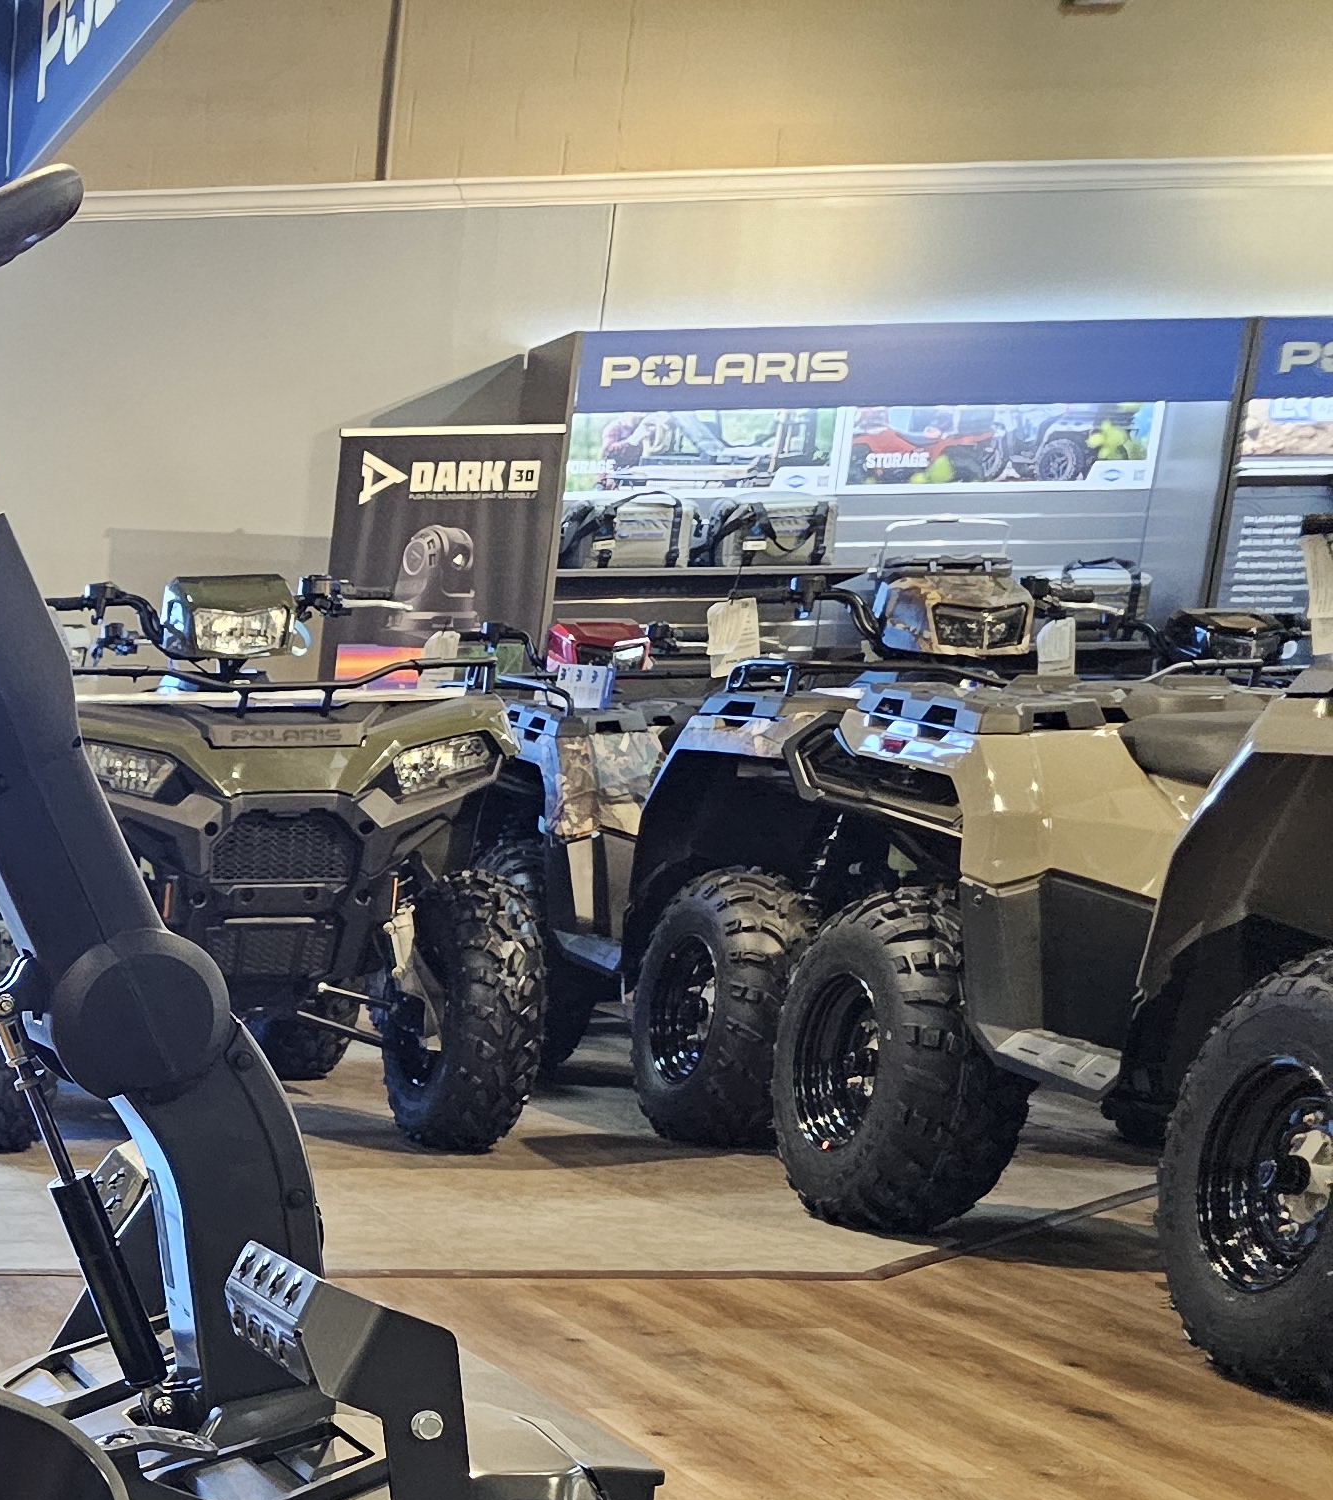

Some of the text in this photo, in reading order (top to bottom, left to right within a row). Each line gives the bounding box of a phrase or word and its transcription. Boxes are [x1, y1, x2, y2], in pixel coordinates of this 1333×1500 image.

[600, 350, 849, 387] POLARIS
[566, 459, 617, 475] ORAGE
[865, 451, 930, 469] STORAGE
[410, 460, 535, 492] DARK 30
[230, 729, 342, 742] POLARIS
